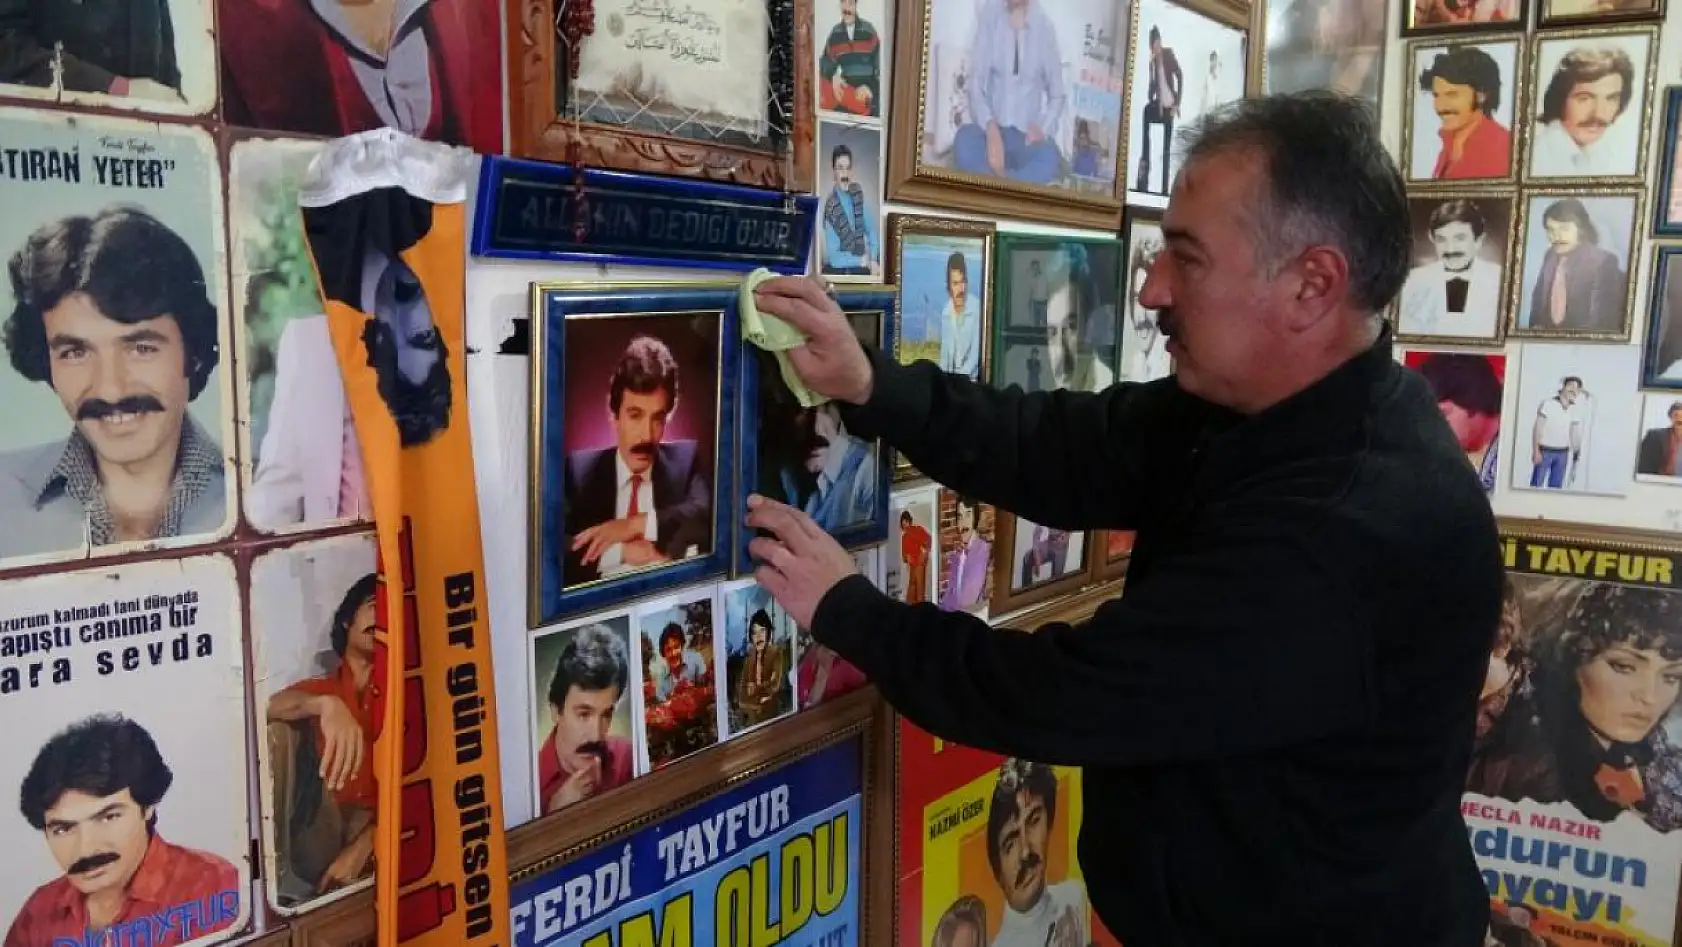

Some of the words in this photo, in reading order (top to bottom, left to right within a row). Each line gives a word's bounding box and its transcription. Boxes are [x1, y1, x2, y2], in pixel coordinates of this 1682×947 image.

[1526, 543, 1673, 584] TAYFUR
[79, 611, 161, 643] canıma
[444, 571, 478, 650] Bir
[97, 632, 212, 675] sevda
[446, 662, 487, 765] gün
[454, 773, 493, 939] gitsen
[1470, 827, 1647, 888] durun
[1530, 812, 1601, 840] NAZIR
[509, 842, 633, 947] FERDİ
[657, 784, 790, 881] TAYFUR
[715, 811, 849, 947] OLDU
